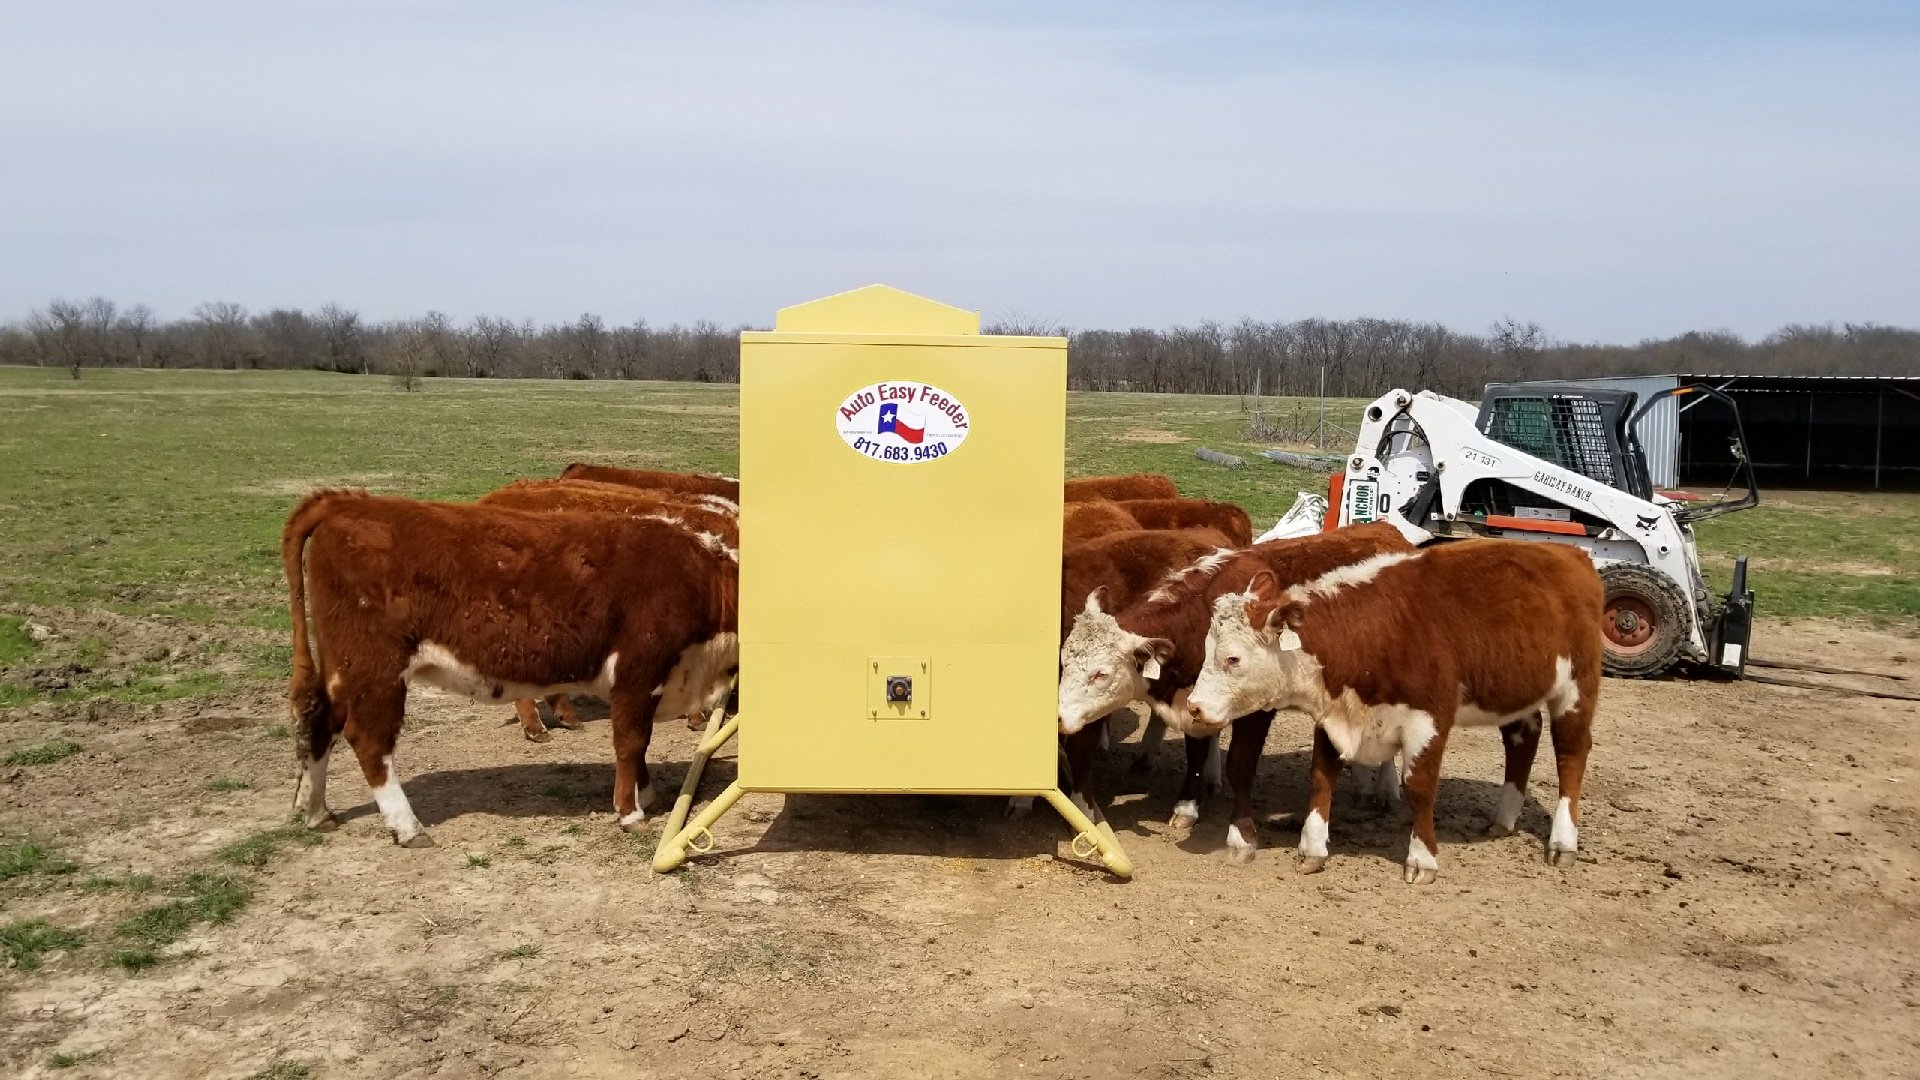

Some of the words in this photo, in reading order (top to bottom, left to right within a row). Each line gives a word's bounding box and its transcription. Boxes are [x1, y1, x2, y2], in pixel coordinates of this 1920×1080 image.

[840, 391, 875, 422] Auto
[878, 384, 916, 403] Easy
[920, 386, 968, 429] Feeder
[854, 437, 948, 461] 817.683.9430
[1354, 485, 1369, 520] NCHOR
